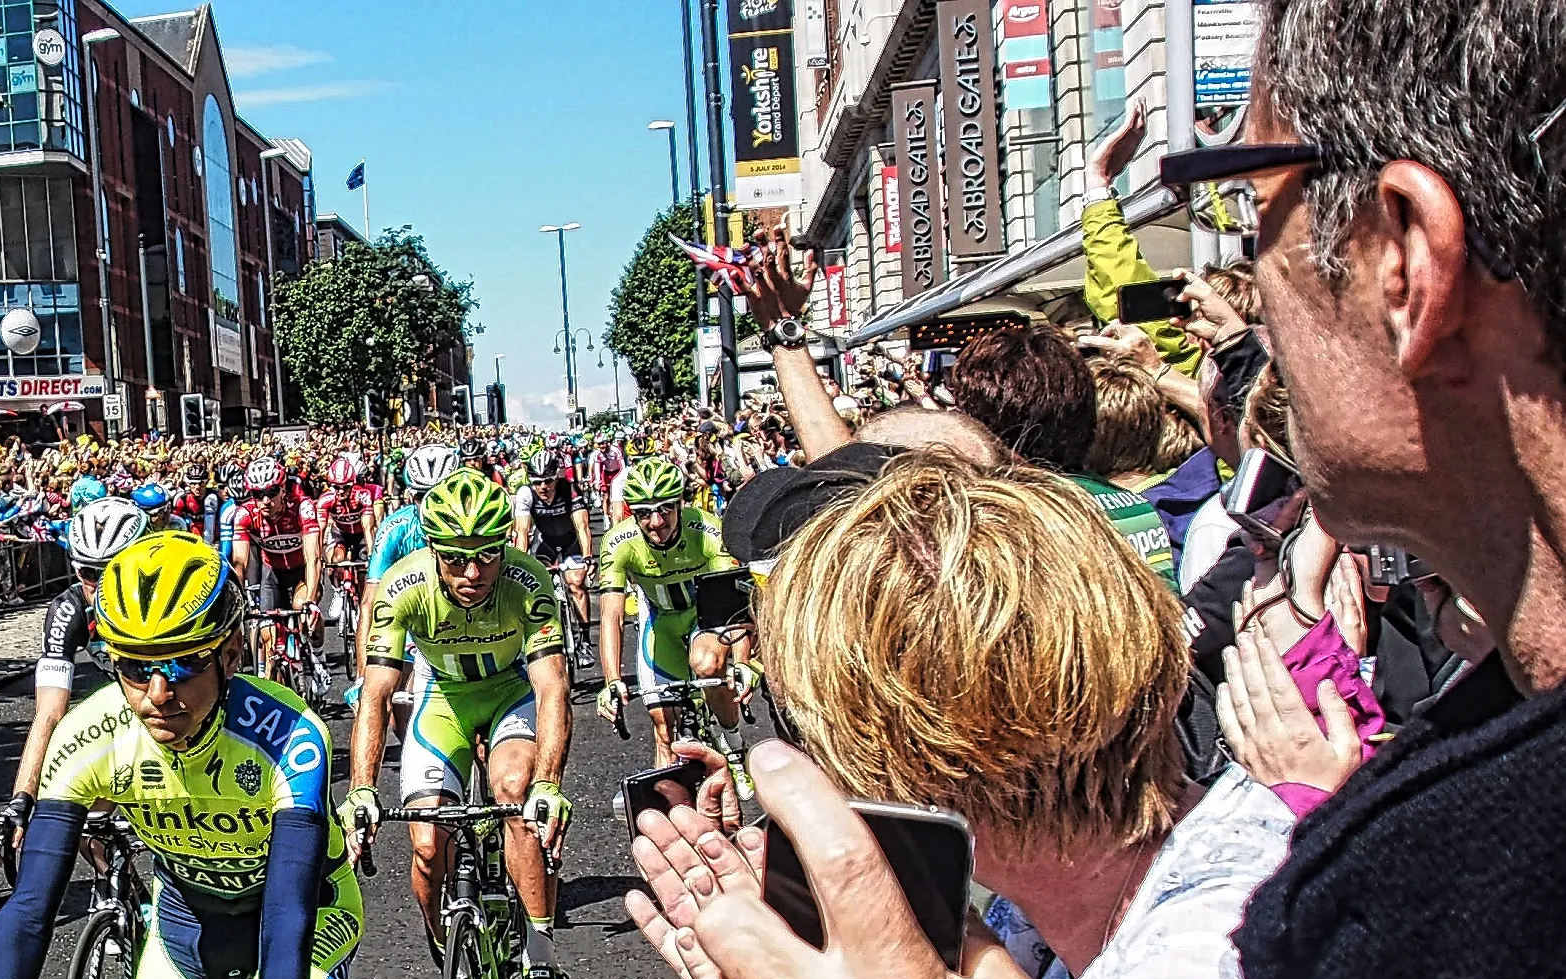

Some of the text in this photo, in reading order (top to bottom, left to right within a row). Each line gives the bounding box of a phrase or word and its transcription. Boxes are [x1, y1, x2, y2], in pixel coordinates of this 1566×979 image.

[39, 43, 62, 55] gym
[12, 72, 34, 86] gym
[750, 47, 775, 149] Yorkshire
[772, 76, 783, 143] Grand Départ
[755, 165, 771, 173] JULY
[105, 404, 120, 417] 15
[609, 530, 639, 549] KENDA
[687, 520, 721, 538] KENDA
[386, 571, 428, 599] KENDA
[504, 565, 541, 594] KENDA
[46, 600, 76, 658] latexco
[237, 695, 322, 773] SAXO
[121, 803, 271, 834] Tinkoff
[174, 865, 266, 890] BANK
